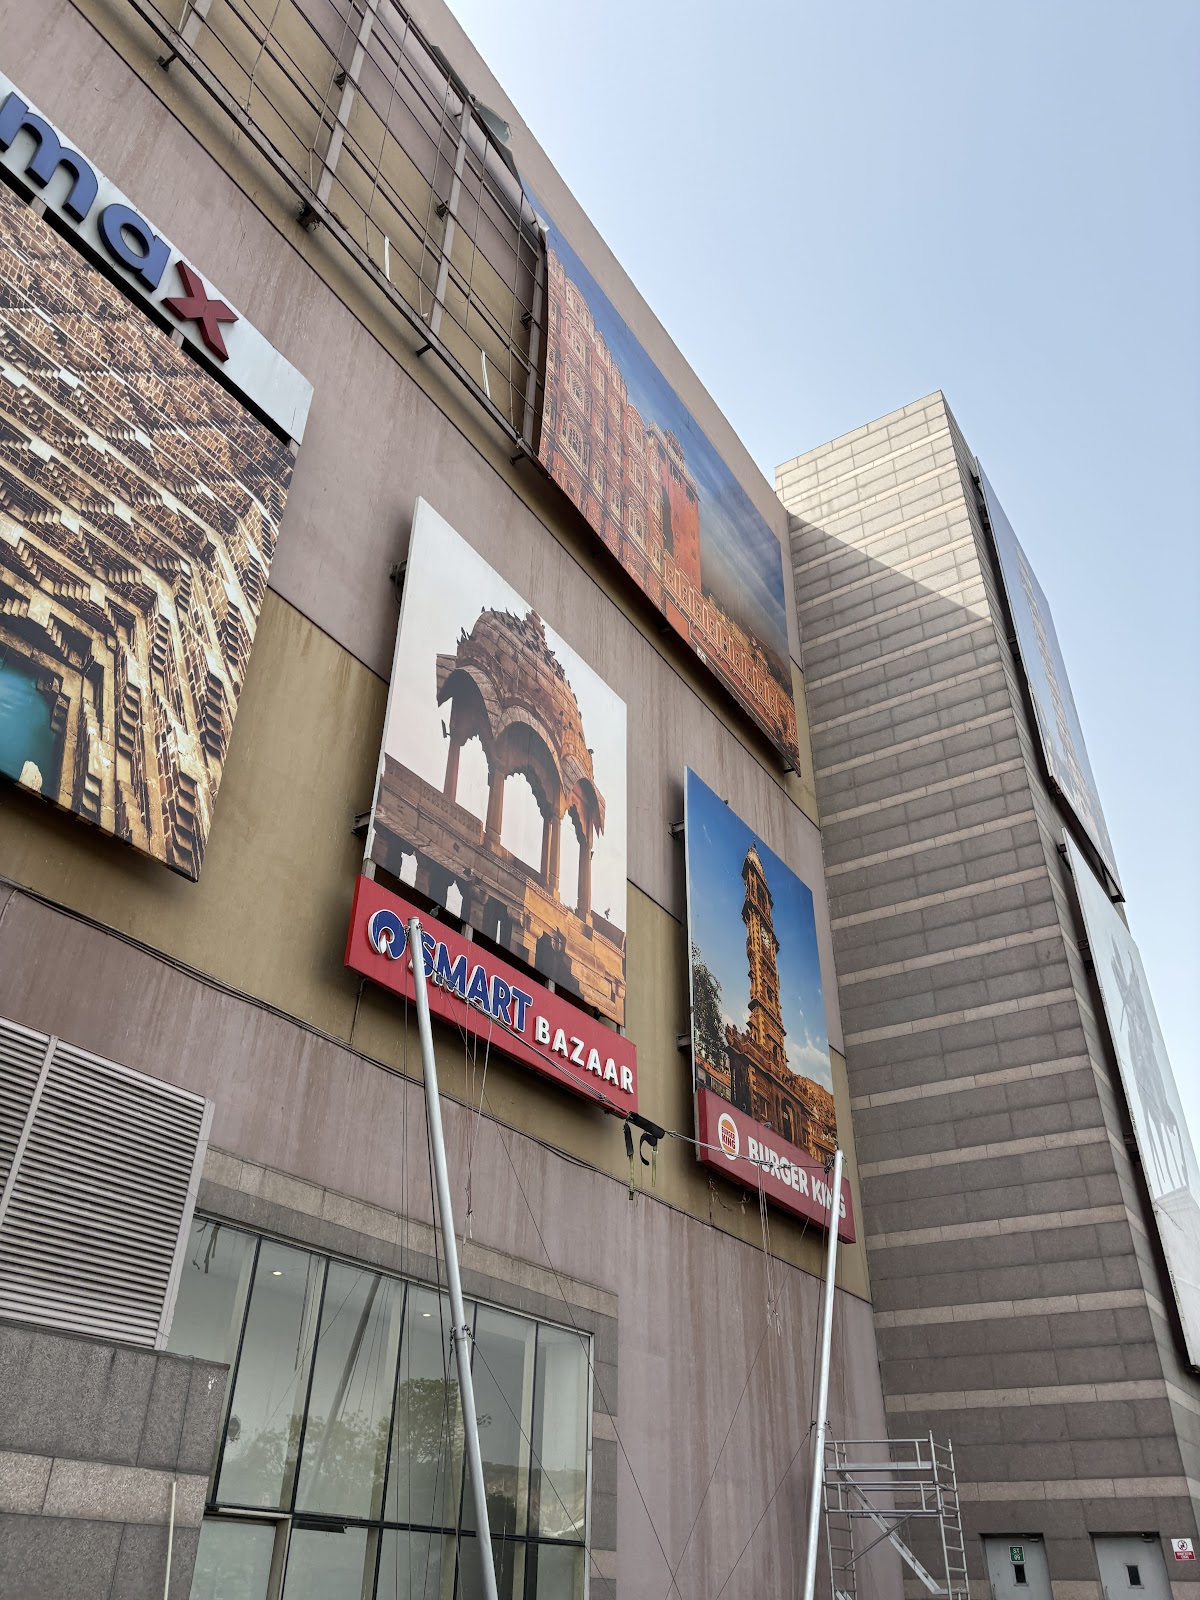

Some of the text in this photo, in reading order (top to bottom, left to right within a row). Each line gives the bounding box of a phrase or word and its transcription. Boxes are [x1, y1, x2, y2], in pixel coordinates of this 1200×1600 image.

[0, 92, 239, 362] max
[408, 931, 635, 1095] SMART BAZAAR
[721, 1133, 736, 1150] KING
[748, 1136, 809, 1197] BURGER
